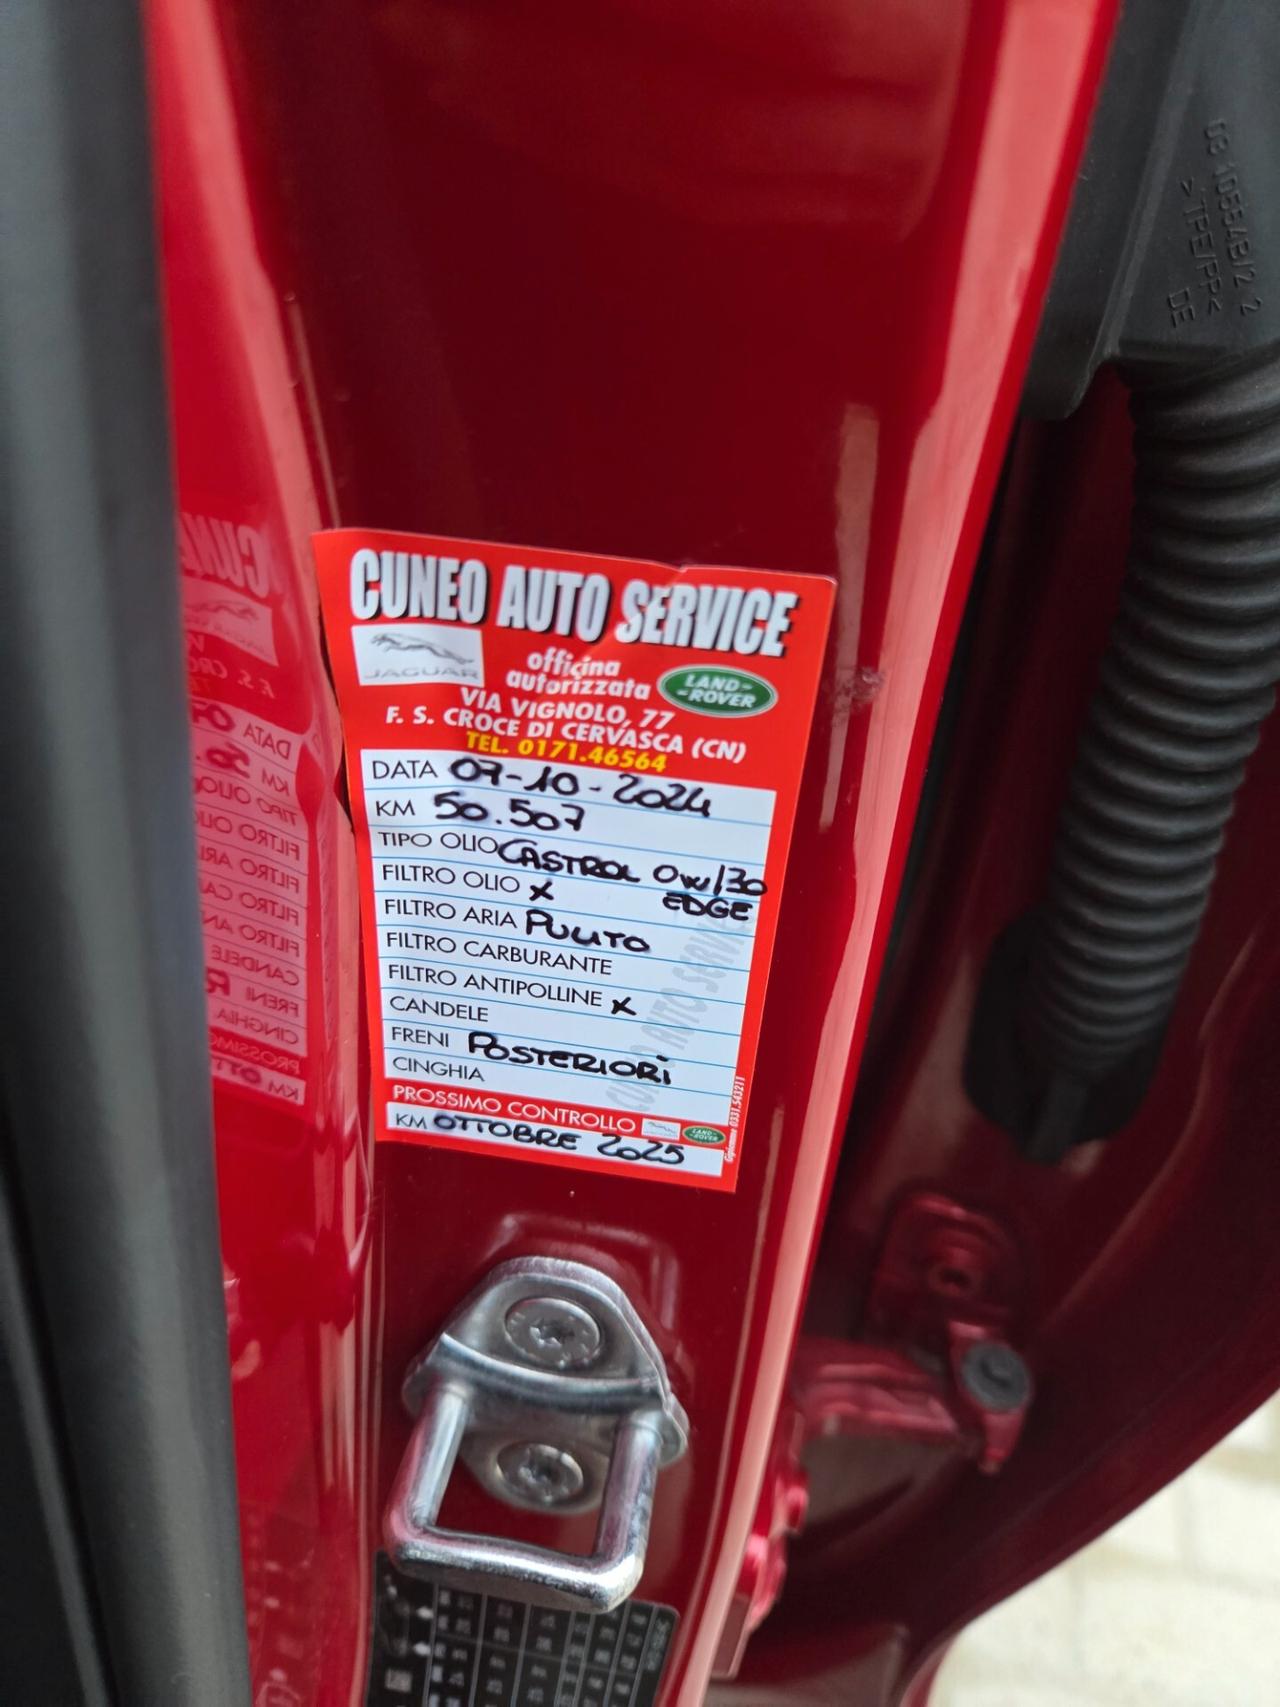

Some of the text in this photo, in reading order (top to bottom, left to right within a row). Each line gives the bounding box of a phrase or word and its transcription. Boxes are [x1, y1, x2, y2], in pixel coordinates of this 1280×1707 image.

[350, 548, 800, 658] CUNEO AUTO SERVICE
[364, 666, 480, 680] JAGUAR
[527, 647, 621, 678] officina
[506, 669, 651, 701] autorizzata
[461, 687, 675, 729] VIA VIGNOLO, 77
[386, 706, 747, 764] F. S. CROCE DI CERVASCA (CN)
[466, 731, 667, 773] TEL. 0171.46564
[372, 760, 438, 780] DATA
[376, 800, 416, 817] KM
[434, 791, 585, 831] 50.507
[378, 832, 499, 854] TIPO OLIO
[497, 838, 641, 883] CASTROL
[382, 864, 520, 893] FILTRO OLIO
[384, 898, 518, 929] FILTRO ARIA
[662, 892, 753, 921] EDGE
[386, 932, 613, 975] FILTRO CARBURANTE
[388, 964, 602, 1007] FILTRO ANTIPOLLINE
[390, 996, 488, 1022] CANDELE
[392, 1026, 449, 1048] FRENI
[393, 1056, 485, 1082] CINGHIA
[392, 1084, 636, 1133] PROSSIMO CONTROLLO
[396, 1113, 427, 1130] KM
[433, 1114, 686, 1166] OTTOBRE 2025
